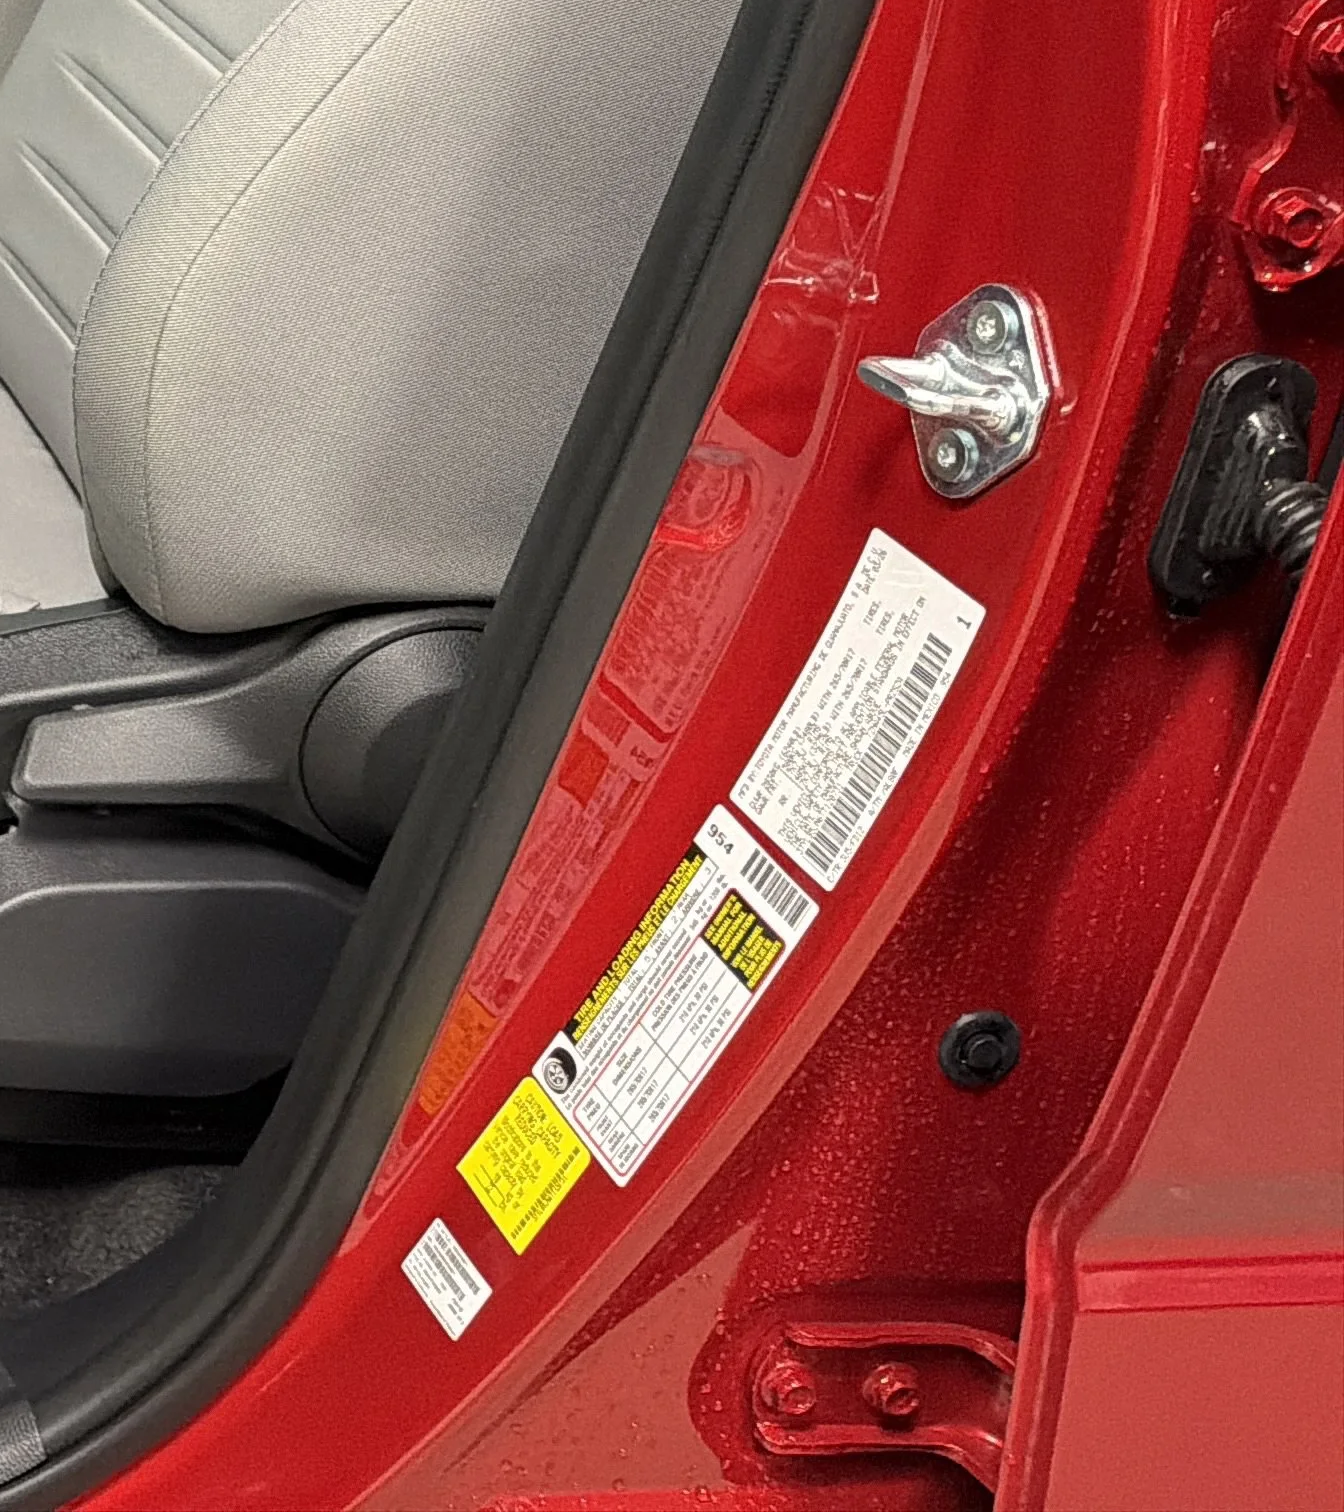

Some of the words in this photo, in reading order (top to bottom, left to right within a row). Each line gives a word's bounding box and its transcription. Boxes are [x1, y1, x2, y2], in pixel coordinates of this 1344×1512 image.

[955, 613, 971, 629] 1
[919, 691, 942, 723] MEXICO
[754, 740, 774, 771] TOYOTA
[770, 717, 788, 744] MOTOR
[705, 821, 736, 857] 954
[614, 960, 630, 981] SUR
[625, 946, 640, 965] LES
[635, 922, 657, 951] PNEUS
[652, 912, 663, 927] ET
[659, 902, 670, 917] LE
[666, 853, 703, 907] CHARGEMENT
[572, 996, 594, 1025] TIRE
[590, 973, 610, 1001] AND
[606, 928, 642, 978] LOADING
[638, 856, 691, 932] INFORMATION
